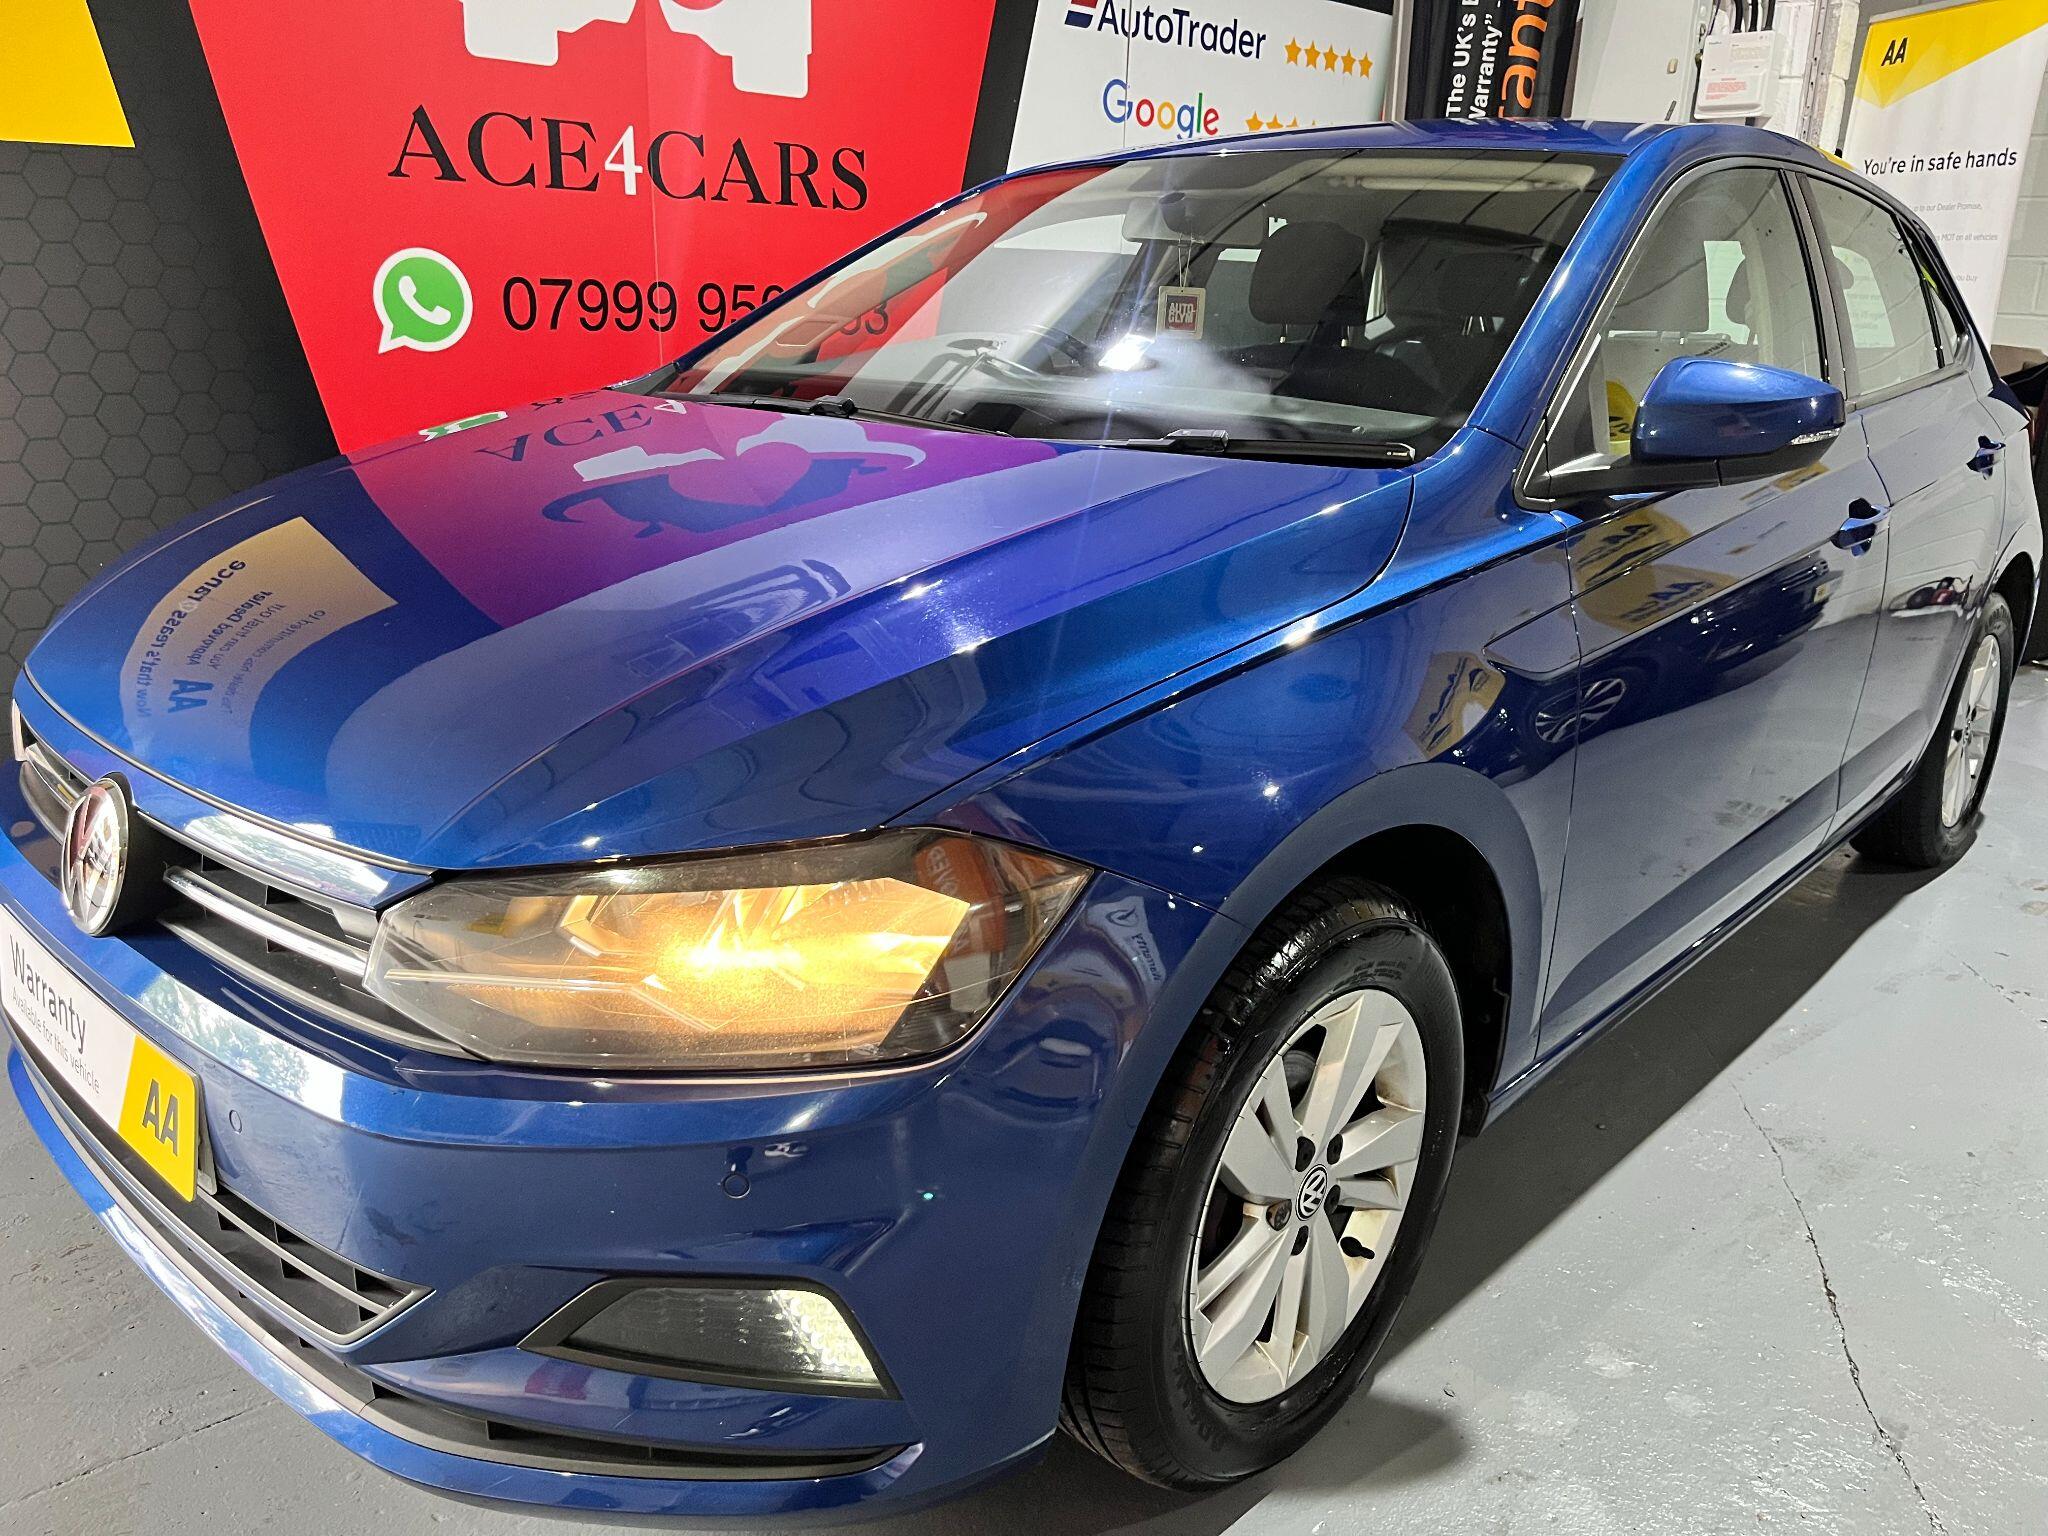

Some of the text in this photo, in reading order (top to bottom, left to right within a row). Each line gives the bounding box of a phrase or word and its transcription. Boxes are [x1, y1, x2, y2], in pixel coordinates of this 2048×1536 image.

[1097, 0, 1266, 59] AutoTrader
[1881, 37, 1908, 67] AA
[1103, 79, 1219, 139] Google
[1445, 73, 1466, 117] The
[388, 104, 868, 211] ACE4CARS
[1863, 147, 2017, 175] You're in safe hands
[502, 276, 677, 333] 07999
[9, 933, 87, 1054] Warranty
[12, 986, 100, 1094] Available for this vehicle
[141, 1079, 180, 1157] AA
